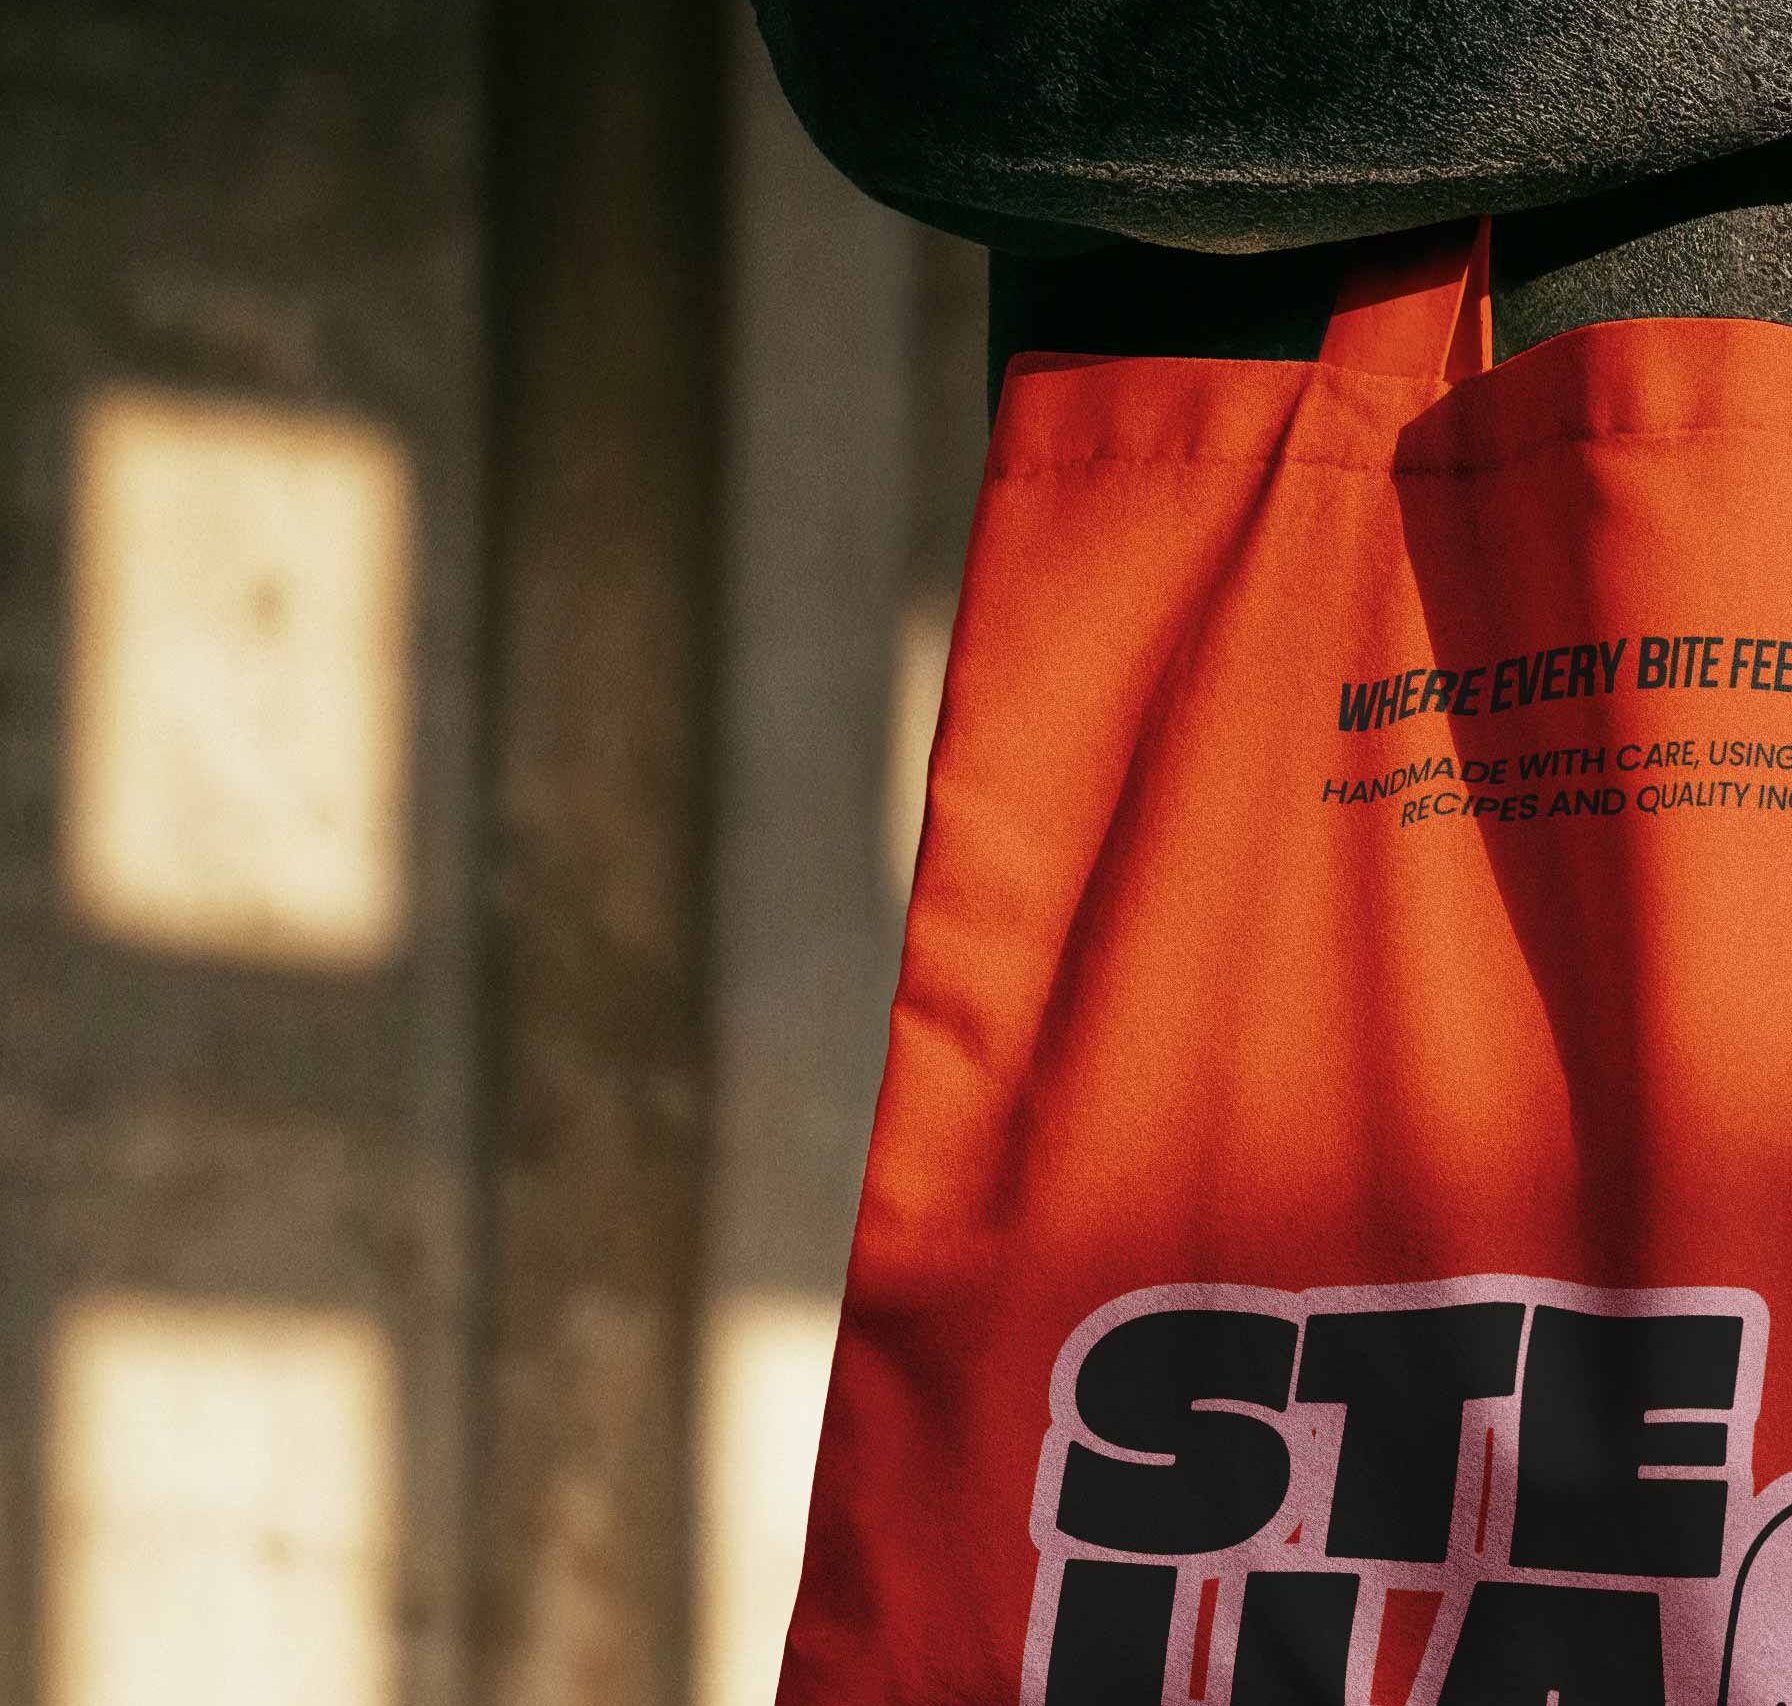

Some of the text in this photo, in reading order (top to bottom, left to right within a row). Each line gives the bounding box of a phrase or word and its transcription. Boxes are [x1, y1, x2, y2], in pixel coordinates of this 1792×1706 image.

[1339, 666, 1486, 733] WHERE
[1488, 637, 1626, 714] EVERY
[1637, 635, 1723, 691] BITE
[1322, 755, 1509, 805] HANDMADE
[1517, 745, 1606, 782] WITH
[1616, 739, 1700, 772] CARE,
[1399, 790, 1539, 829] RECIPES
[1550, 788, 1627, 818] AND
[1636, 780, 1749, 816] QUALITY
[1054, 1301, 1745, 1579] STE
